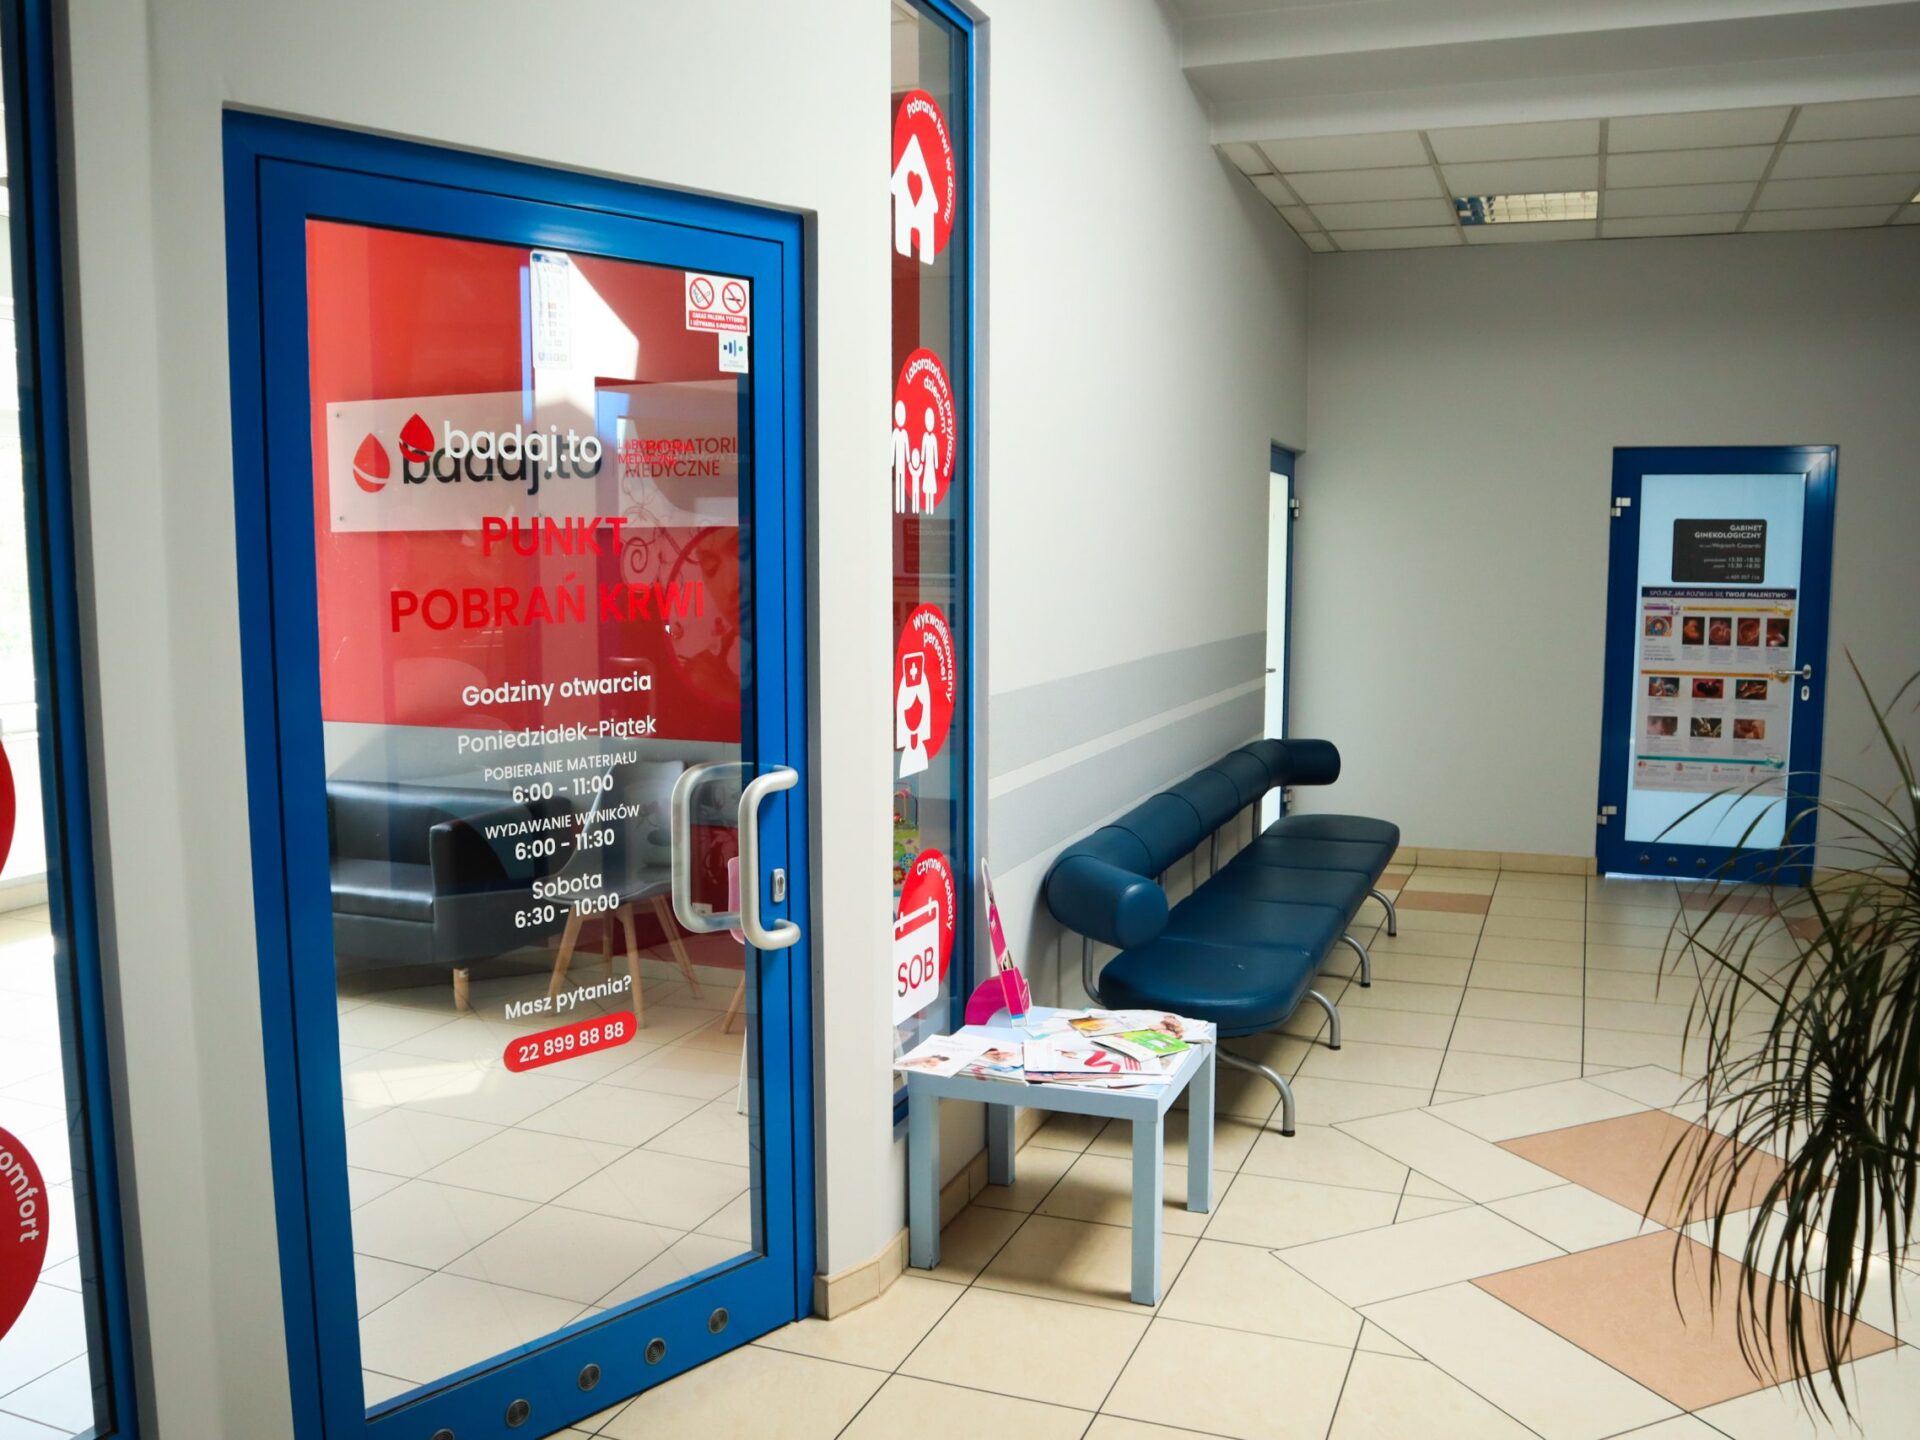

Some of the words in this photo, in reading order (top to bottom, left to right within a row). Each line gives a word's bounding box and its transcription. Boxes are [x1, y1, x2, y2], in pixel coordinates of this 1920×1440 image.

[906, 97, 937, 123] Pobranie
[936, 118, 949, 154] krwi
[946, 157, 952, 171] w
[944, 176, 954, 224] domu
[905, 358, 947, 399] Laboratorium
[944, 400, 954, 477] przyjazne
[444, 420, 602, 472] badaj.to
[625, 437, 736, 457] LABORATORI
[482, 515, 628, 557] PUNKT
[1694, 531, 1762, 539] GINEKOLOGICZNY
[1729, 524, 1763, 532] GABINET
[390, 572, 586, 632] POBRAŃ
[601, 581, 704, 622] KRWI
[913, 609, 953, 703] Wykwalifikowany
[923, 632, 947, 682] personel
[462, 680, 554, 706] Godziny
[559, 670, 652, 698] otwarcia
[457, 715, 657, 754] Poniedziałek-Piątek
[484, 759, 563, 782] POBIERANIE
[567, 750, 638, 775] MATERIAŁU
[512, 782, 553, 804] 6:00
[573, 774, 614, 796] 11:00
[484, 814, 572, 840] WYDAWANIE
[575, 804, 640, 831] WYNIKÓW
[515, 838, 556, 861] 6:00
[575, 828, 615, 851] 11:30
[532, 872, 603, 900] Sobota
[916, 858, 942, 876] Czynne
[944, 879, 953, 930] soboty
[514, 905, 554, 929] 6:30
[574, 892, 620, 917] 10:00
[897, 946, 934, 998] SOB
[505, 996, 552, 1020] Masz
[556, 975, 632, 1012] pytania?
[519, 1043, 539, 1063] 22
[543, 1034, 575, 1056] 899
[579, 1027, 600, 1047] 88
[604, 1021, 624, 1040] 88
[0, 1145, 39, 1242] omfort
